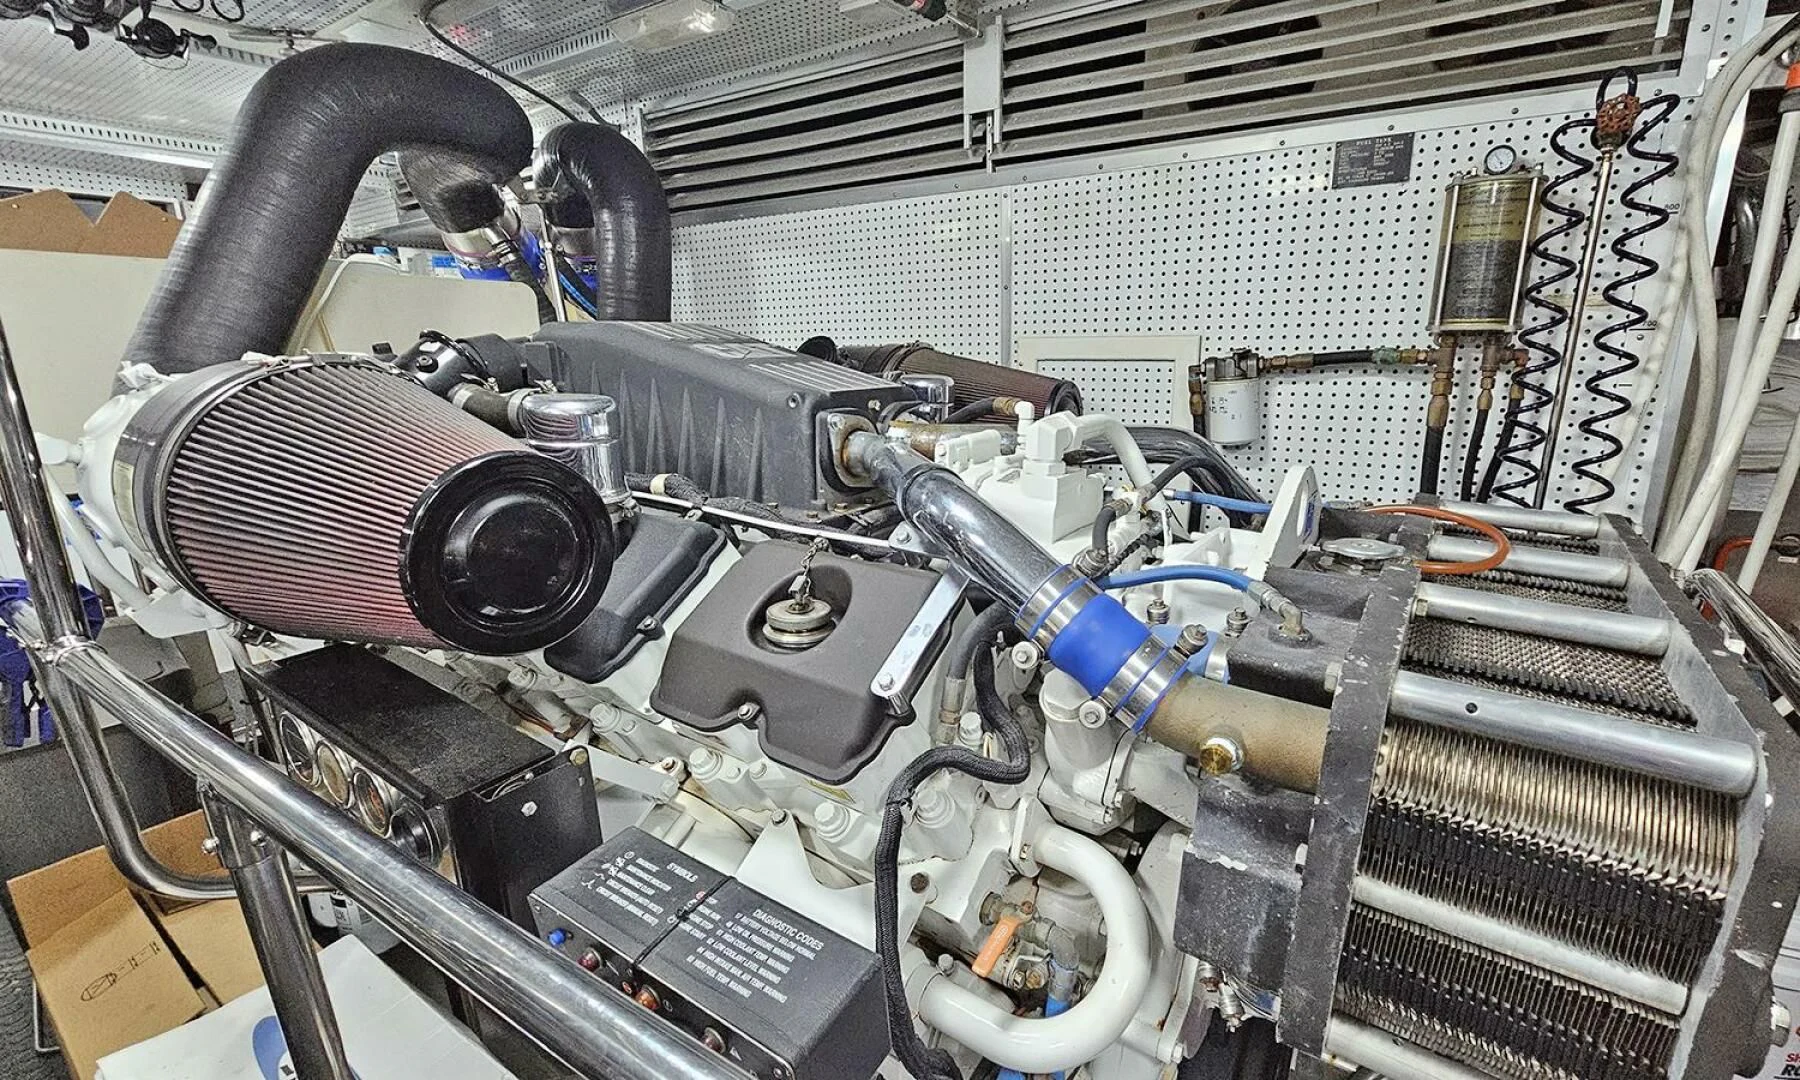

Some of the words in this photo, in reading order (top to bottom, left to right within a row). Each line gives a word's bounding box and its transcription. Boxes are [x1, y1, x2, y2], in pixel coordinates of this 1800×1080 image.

[667, 863, 698, 882] SYMBOLS
[752, 909, 797, 936] DIAGNOSTIC
[796, 932, 824, 950] CODES
